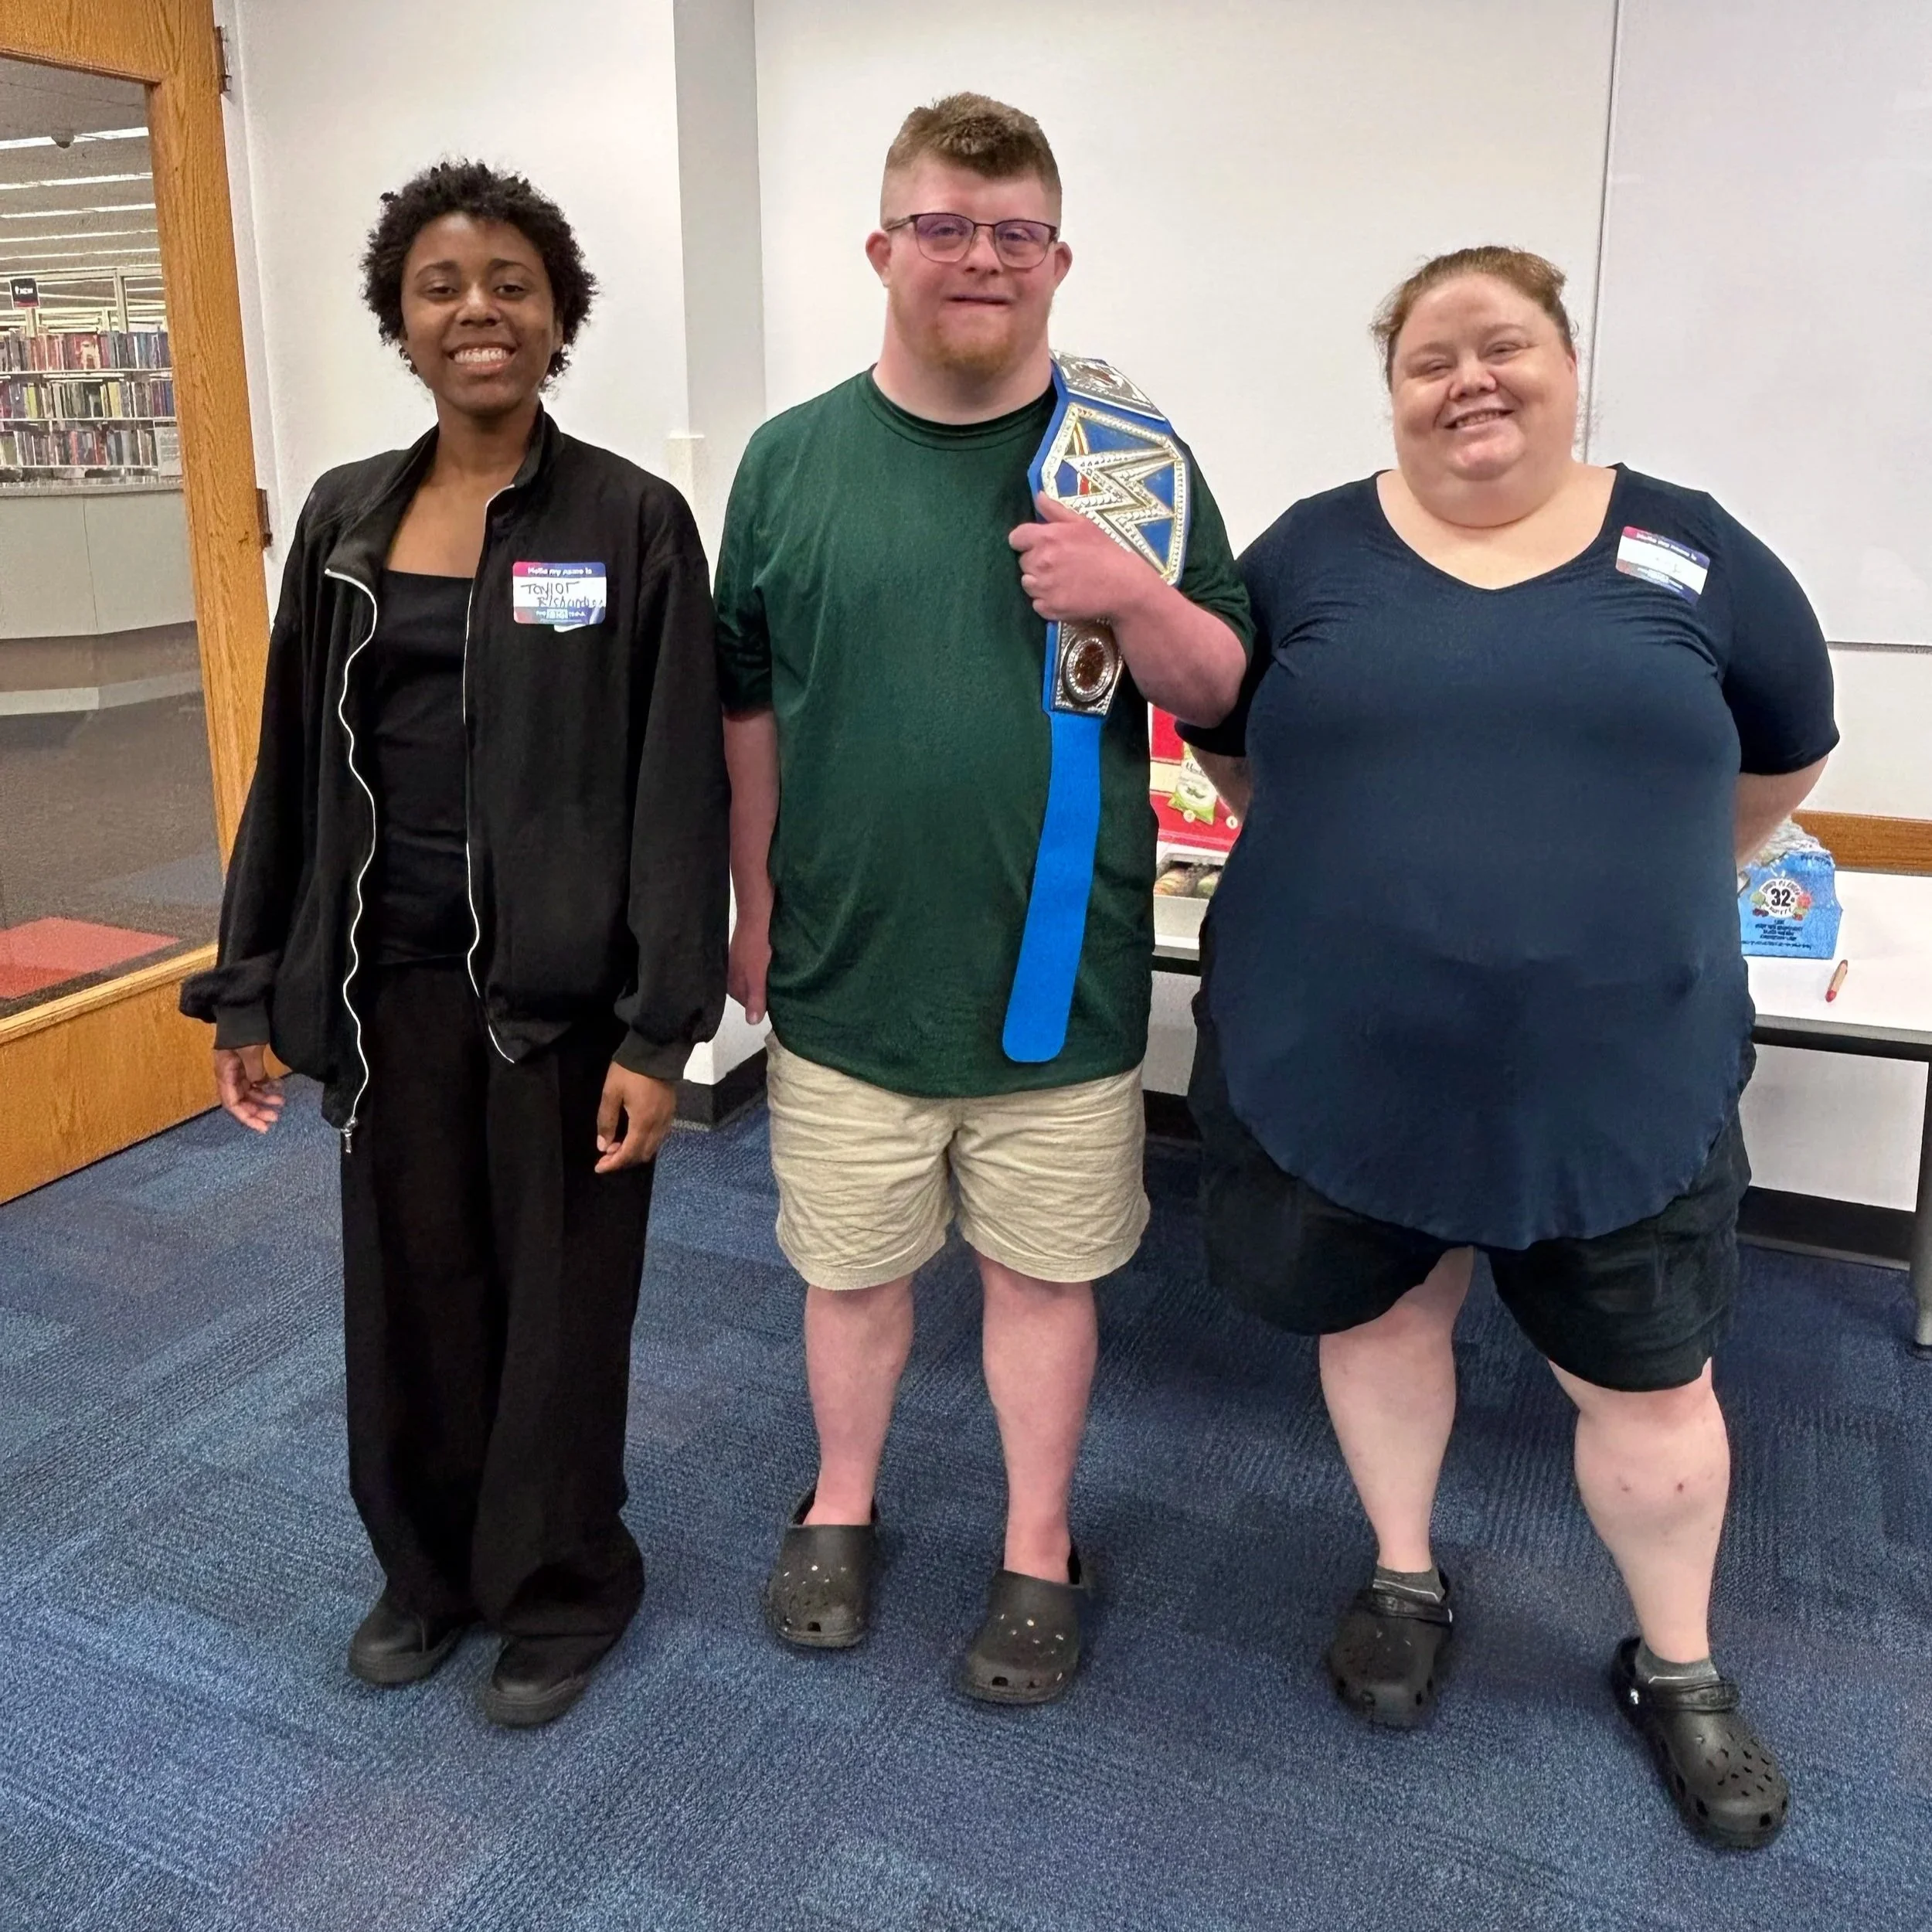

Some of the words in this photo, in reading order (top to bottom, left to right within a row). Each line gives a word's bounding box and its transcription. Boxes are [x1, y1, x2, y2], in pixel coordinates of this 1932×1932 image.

[527, 566, 548, 575] Hello
[549, 568, 561, 577] my
[520, 580, 580, 600] Taylor
[1770, 888, 1791, 907] 32
